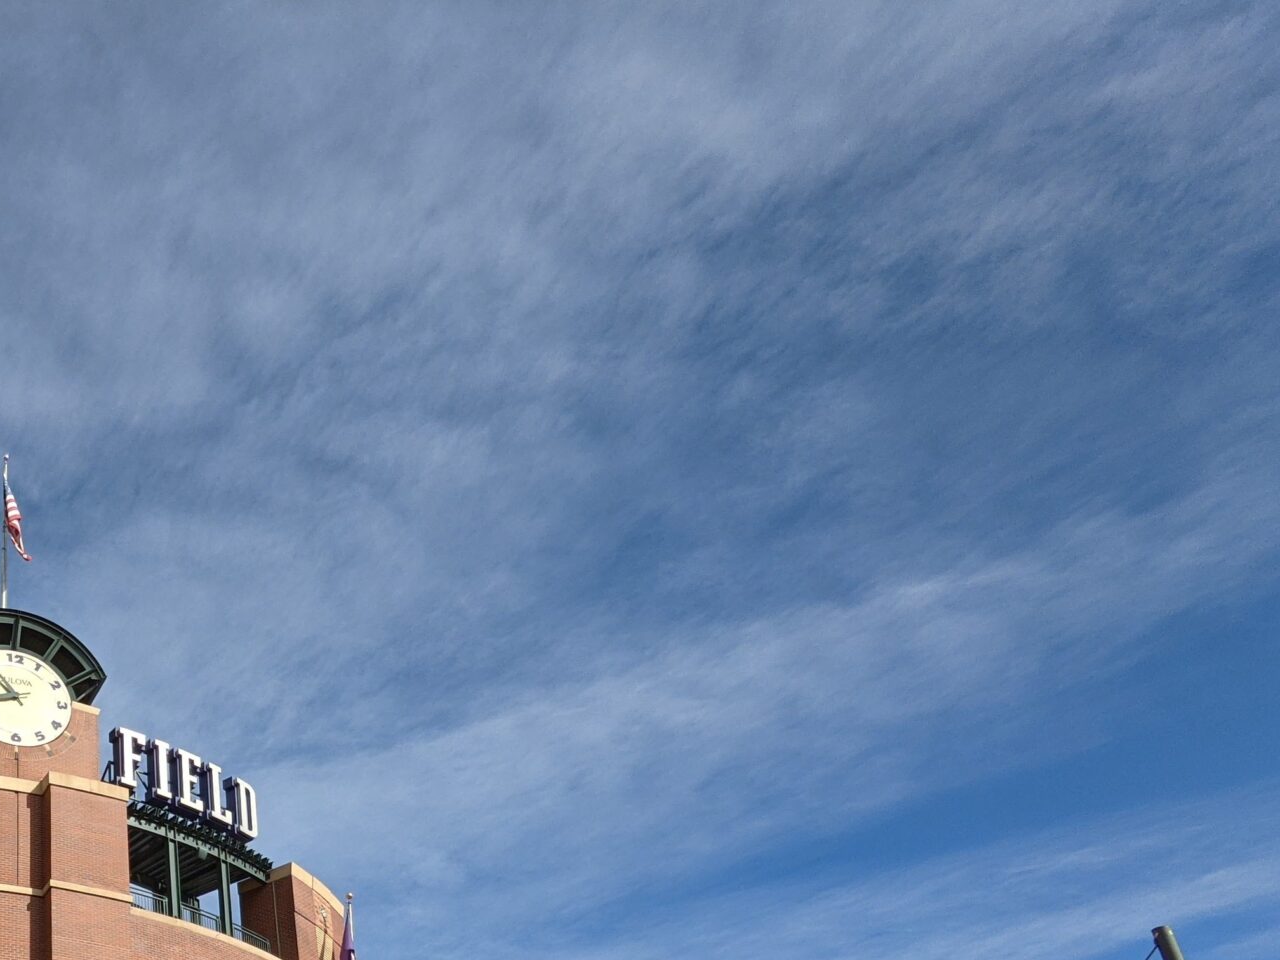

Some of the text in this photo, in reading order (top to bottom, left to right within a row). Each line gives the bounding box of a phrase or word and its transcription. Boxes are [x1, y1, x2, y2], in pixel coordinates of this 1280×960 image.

[6, 653, 24, 665] 12
[34, 663, 43, 672] 1
[49, 681, 61, 690] 2
[57, 701, 67, 710] 3
[51, 720, 62, 730] 4
[11, 733, 21, 742] 6
[34, 731, 45, 741] 5
[109, 727, 260, 843] FIELD
